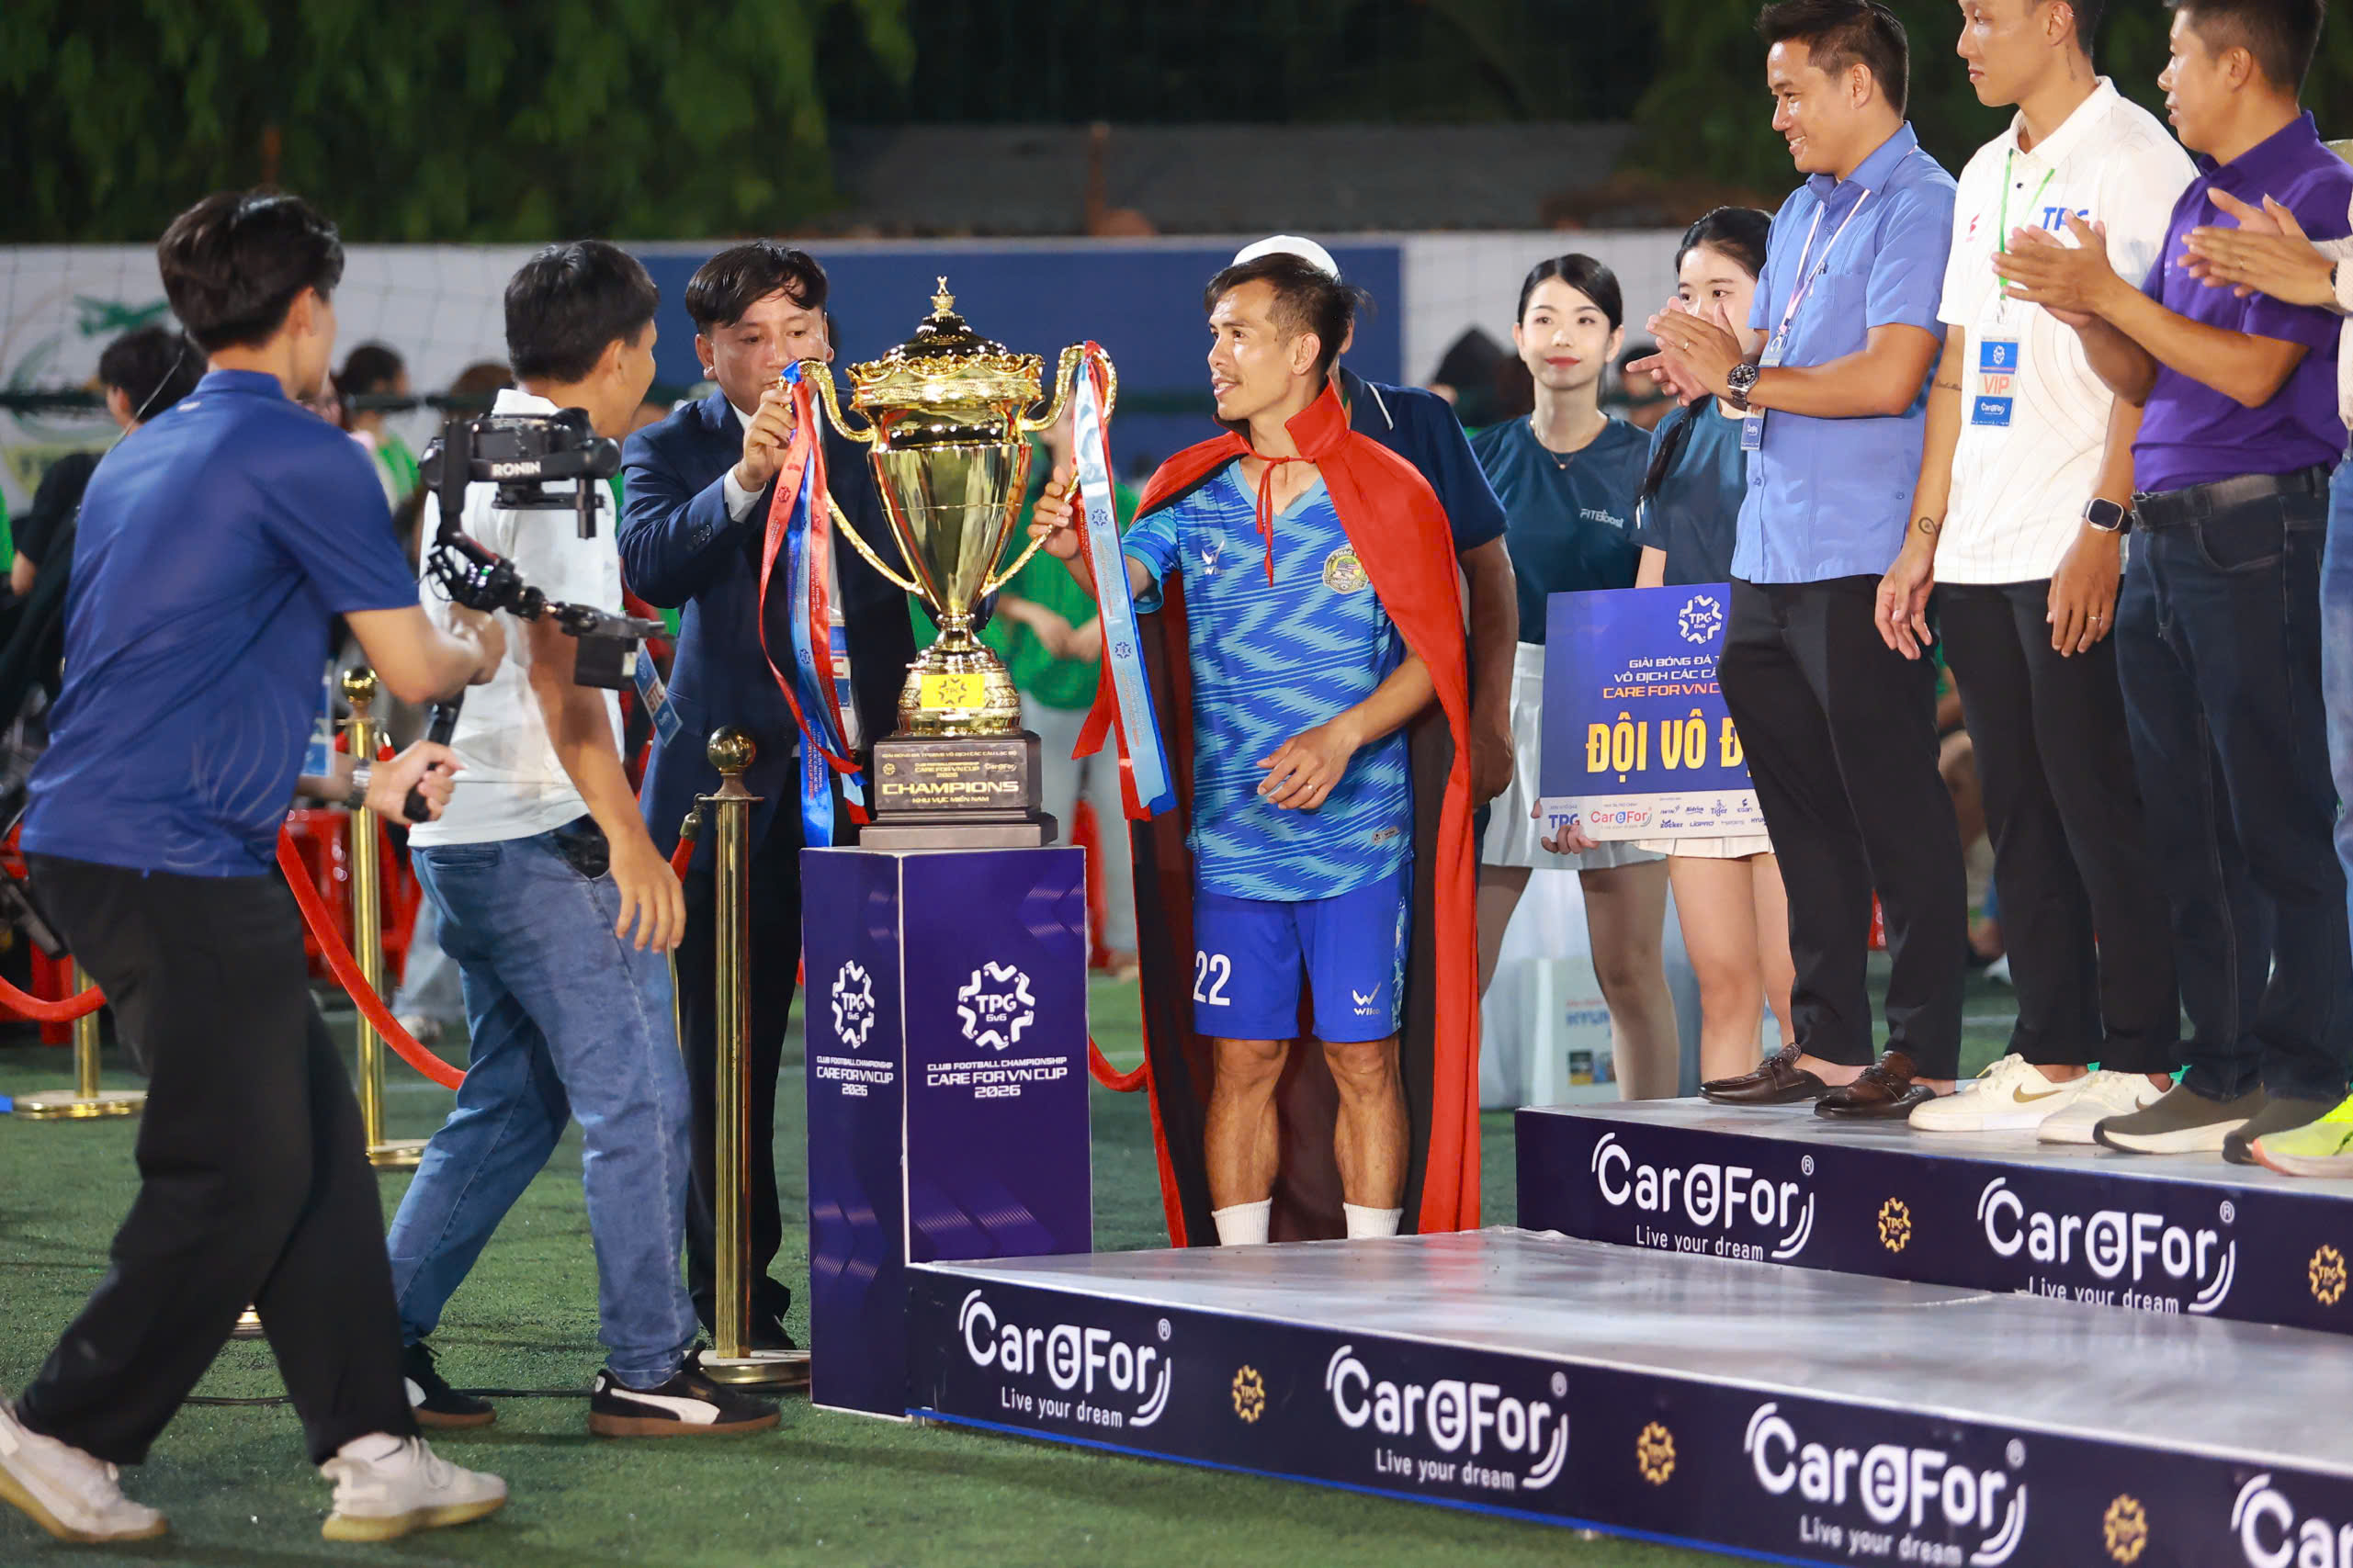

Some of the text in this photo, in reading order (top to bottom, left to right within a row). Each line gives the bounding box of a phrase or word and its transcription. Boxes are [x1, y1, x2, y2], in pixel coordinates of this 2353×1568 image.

[1984, 375, 2010, 395] VIP
[492, 460, 542, 478] RONIN
[1689, 612, 1713, 624] TPG
[1656, 655, 1691, 668] BÓNG
[1693, 653, 1713, 665] ĐÁ
[1613, 671, 1634, 683] VÔ
[1635, 671, 1668, 684] ĐỊCH
[1670, 669, 1699, 681] CÁC
[1602, 685, 1646, 699] CARE
[1648, 683, 1680, 697] FOR
[1681, 682, 1708, 695] VN
[1585, 711, 1648, 784] ĐỘI
[1660, 708, 1708, 771] VÔ
[882, 781, 1019, 795] CHAMPIONS
[1590, 810, 1648, 824] CareFor
[1711, 807, 1727, 817] Tiger
[1193, 950, 1231, 1007] 22
[842, 992, 865, 1011] TPG
[975, 993, 1017, 1013] TPG
[986, 1012, 1007, 1022] 6v6
[817, 1055, 893, 1069] CLUB FOOTBALL CHAMPIONSHIP
[927, 1056, 1067, 1072] CLUB FOOTBALL CHAMPIONSHIP
[816, 1066, 894, 1084] CARE FOR VN CUP
[927, 1066, 1068, 1087] CARE FOR VN CUP
[842, 1083, 868, 1097] 2026
[974, 1084, 1022, 1099] 2026
[1598, 1144, 1799, 1229] CareFor
[1635, 1224, 1763, 1261] Live your dream
[1985, 1190, 2217, 1281] CareFor
[2029, 1275, 2179, 1314] Live your dream
[965, 1301, 1156, 1394] CareFor
[1001, 1386, 1123, 1428] Live your dream
[1333, 1358, 1551, 1455] CareFor
[1376, 1448, 1515, 1491] Live your dream
[1752, 1416, 2006, 1529] CareFor
[1799, 1514, 1963, 1565] Live your dream
